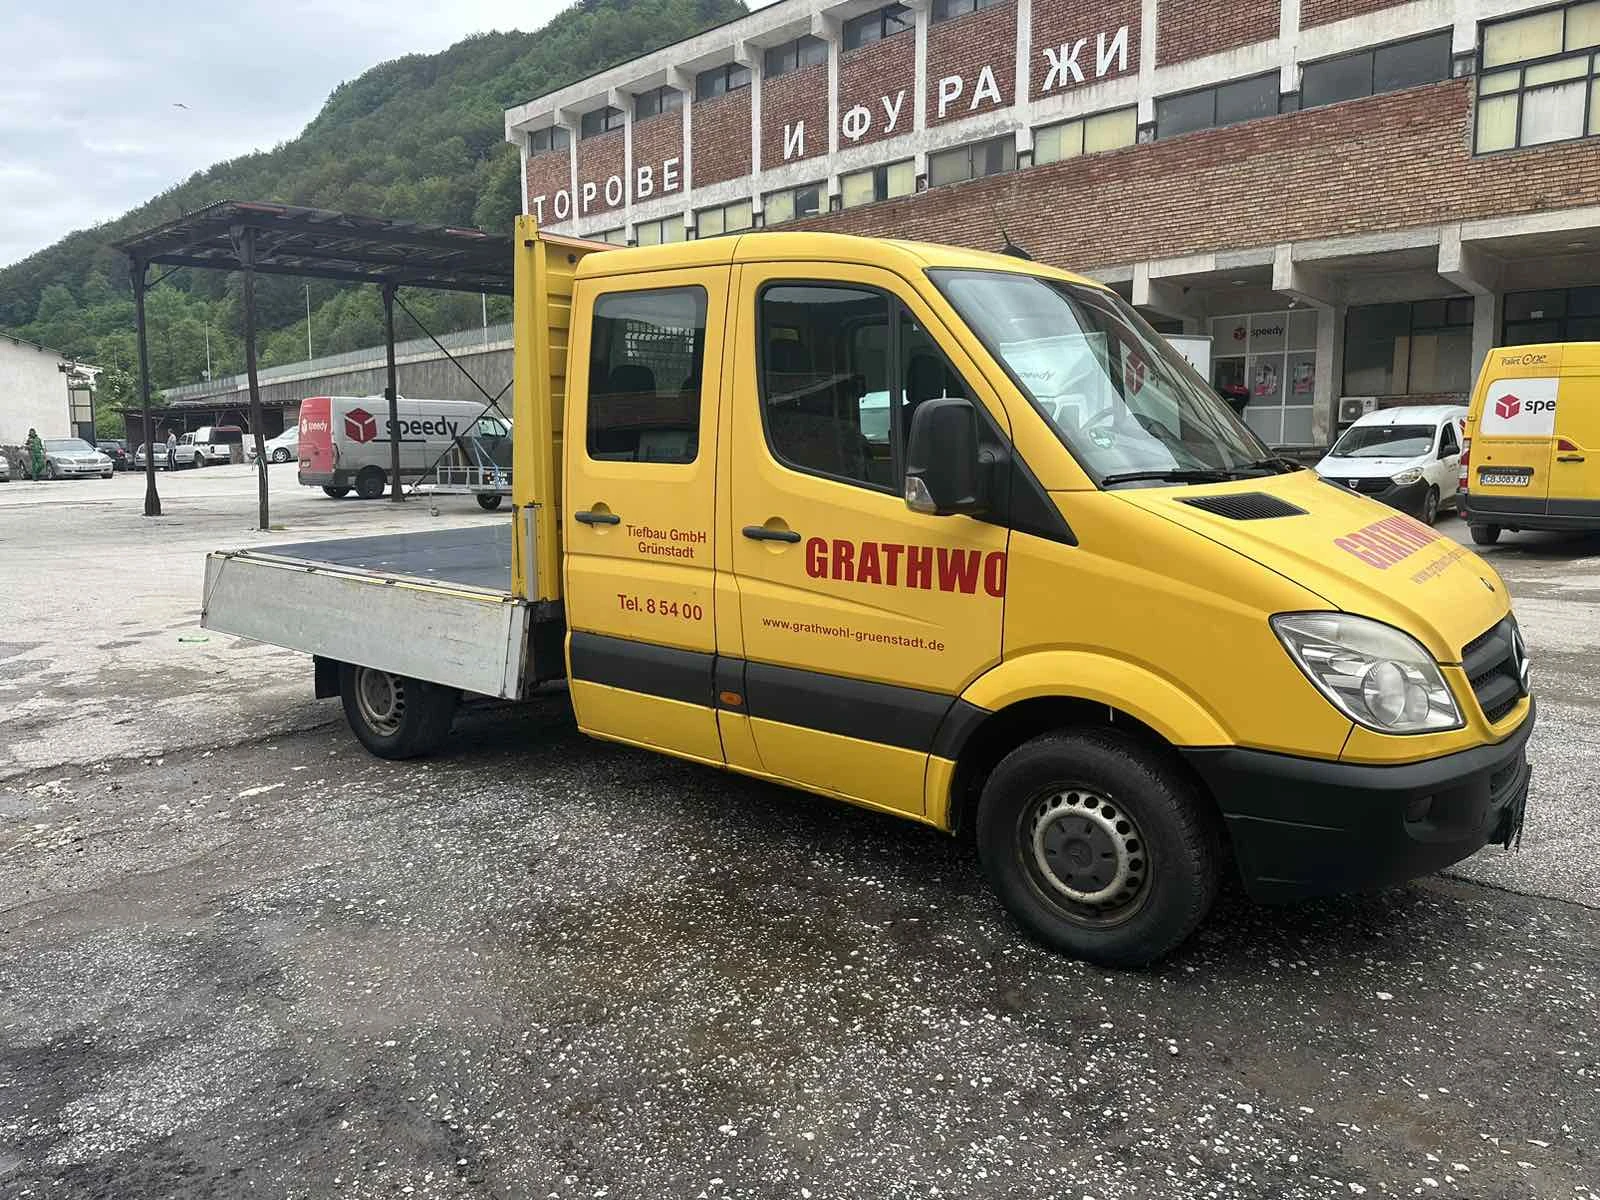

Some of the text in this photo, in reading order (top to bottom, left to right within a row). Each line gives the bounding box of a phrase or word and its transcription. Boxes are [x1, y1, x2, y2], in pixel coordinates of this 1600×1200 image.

[533, 25, 1129, 223] ТОРОВЕ И ФУРАЖИ
[1250, 325, 1284, 338] speedy
[1524, 400, 1556, 415] spe
[308, 419, 328, 432] speedy
[385, 415, 458, 441] speedy
[626, 525, 708, 544] Tiefbau GmbH
[638, 542, 695, 559] Grünstadt
[805, 536, 1007, 599] GRATHWO
[617, 593, 703, 621] Tel. 8 54 00
[762, 616, 945, 652] www.grathwohl-gruenstadt.de
